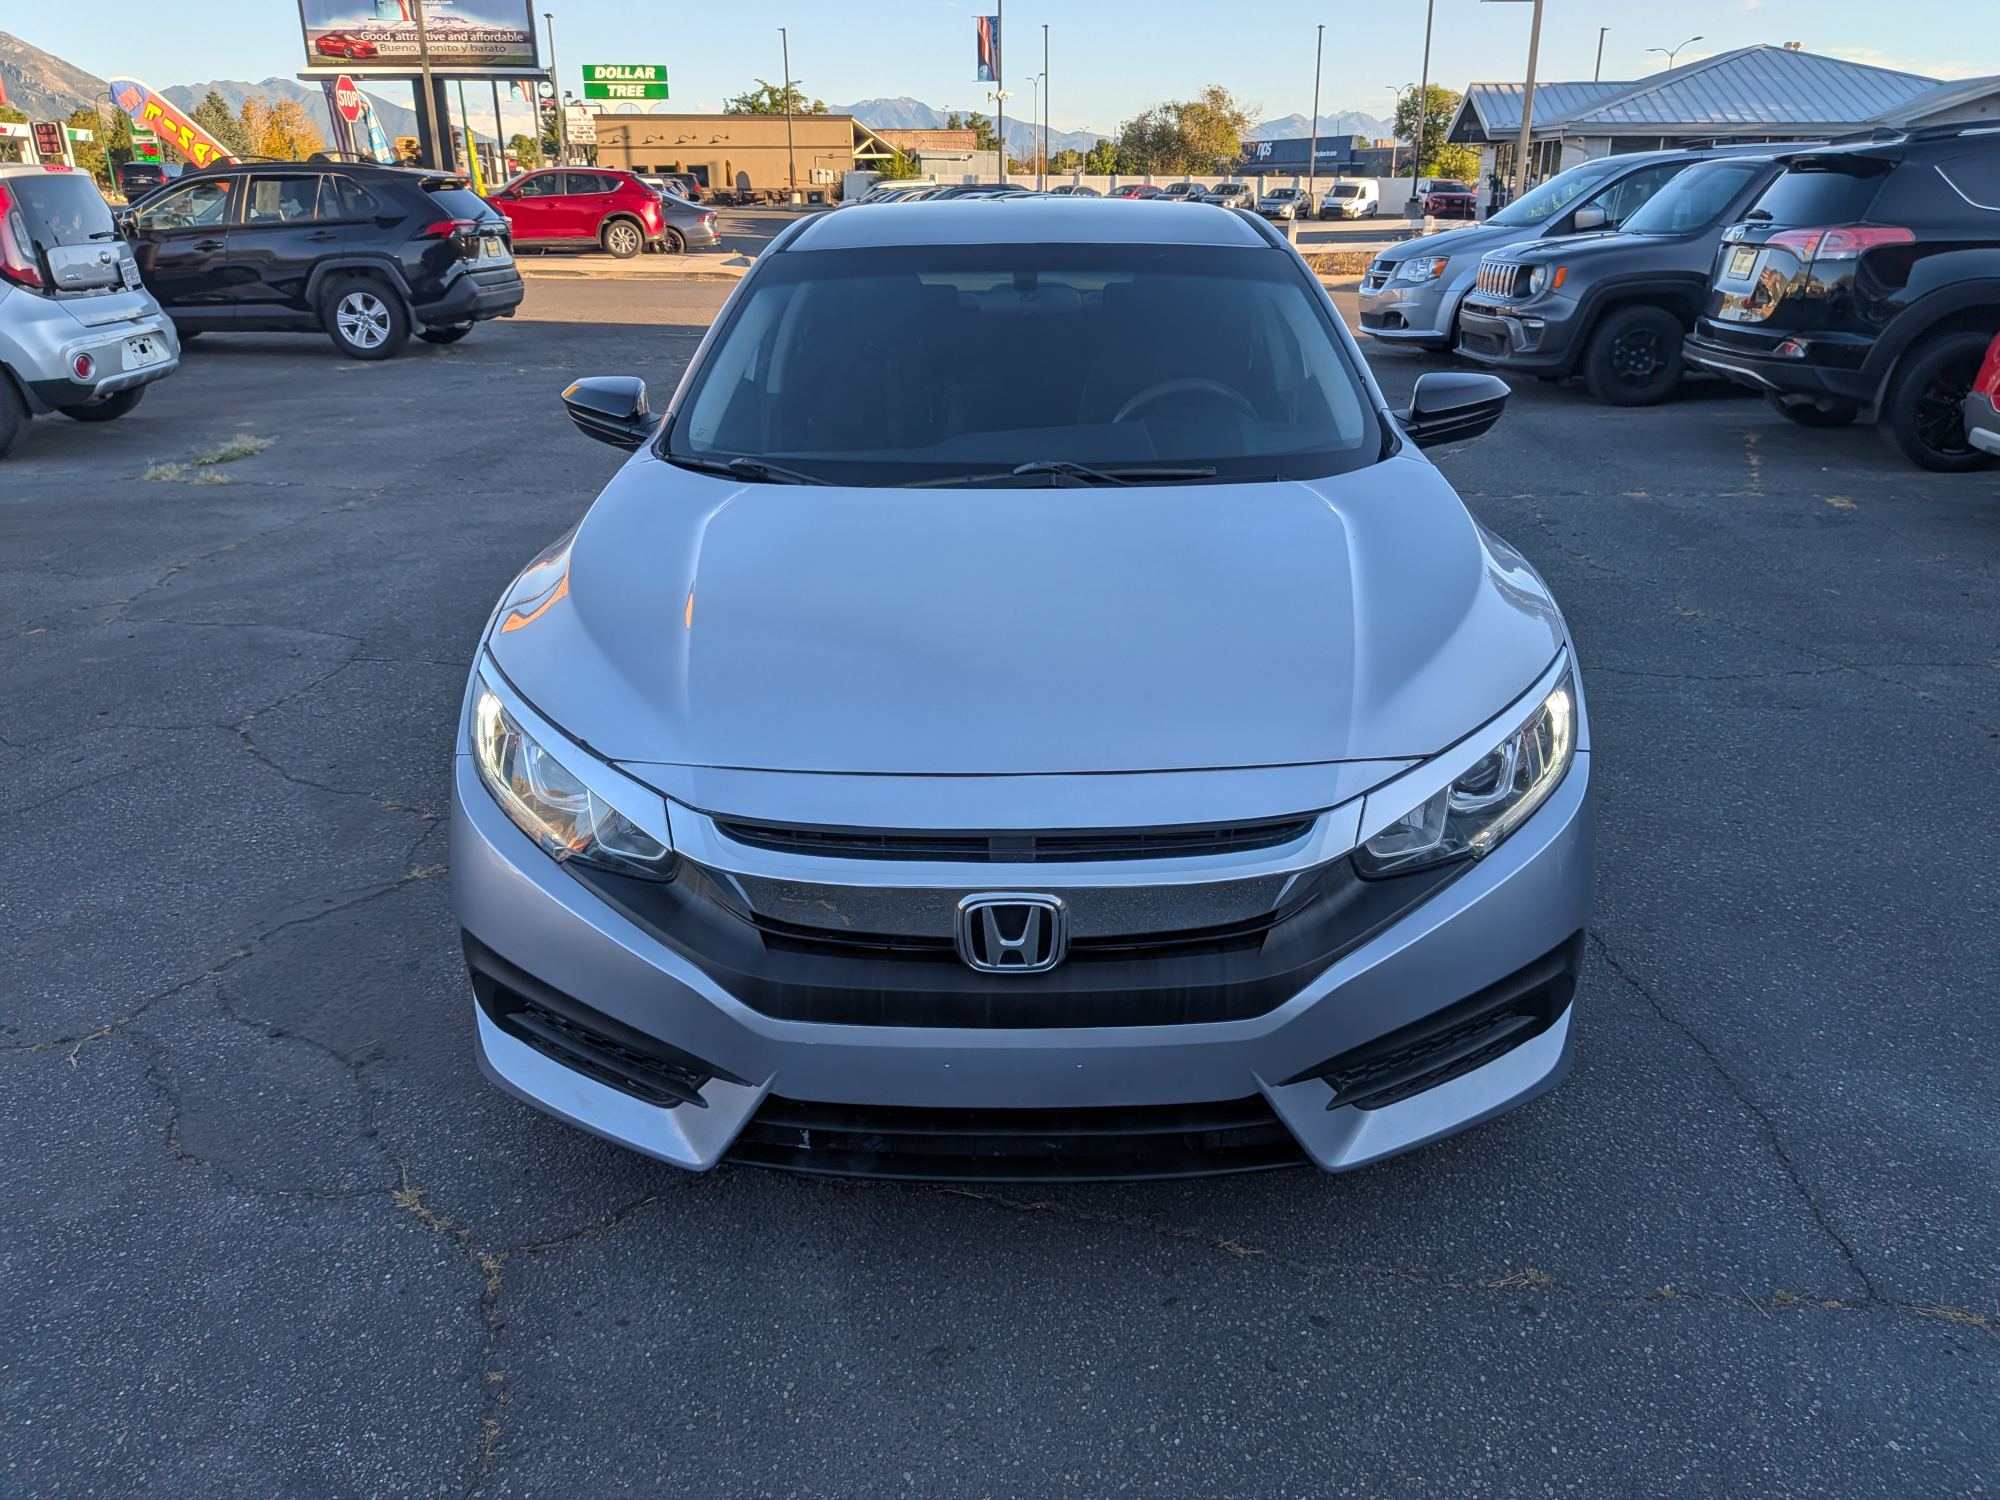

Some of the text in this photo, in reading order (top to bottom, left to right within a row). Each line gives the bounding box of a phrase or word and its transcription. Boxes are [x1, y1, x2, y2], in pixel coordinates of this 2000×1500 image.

[360, 31, 524, 42] Good, attrative and affordable
[380, 44, 507, 53] Bueno, onito y barato
[594, 66, 656, 79] DOLLAR
[606, 85, 646, 97] TREE
[338, 90, 358, 108] STOP
[38, 125, 53, 134] LAT
[1256, 142, 1272, 160] nps
